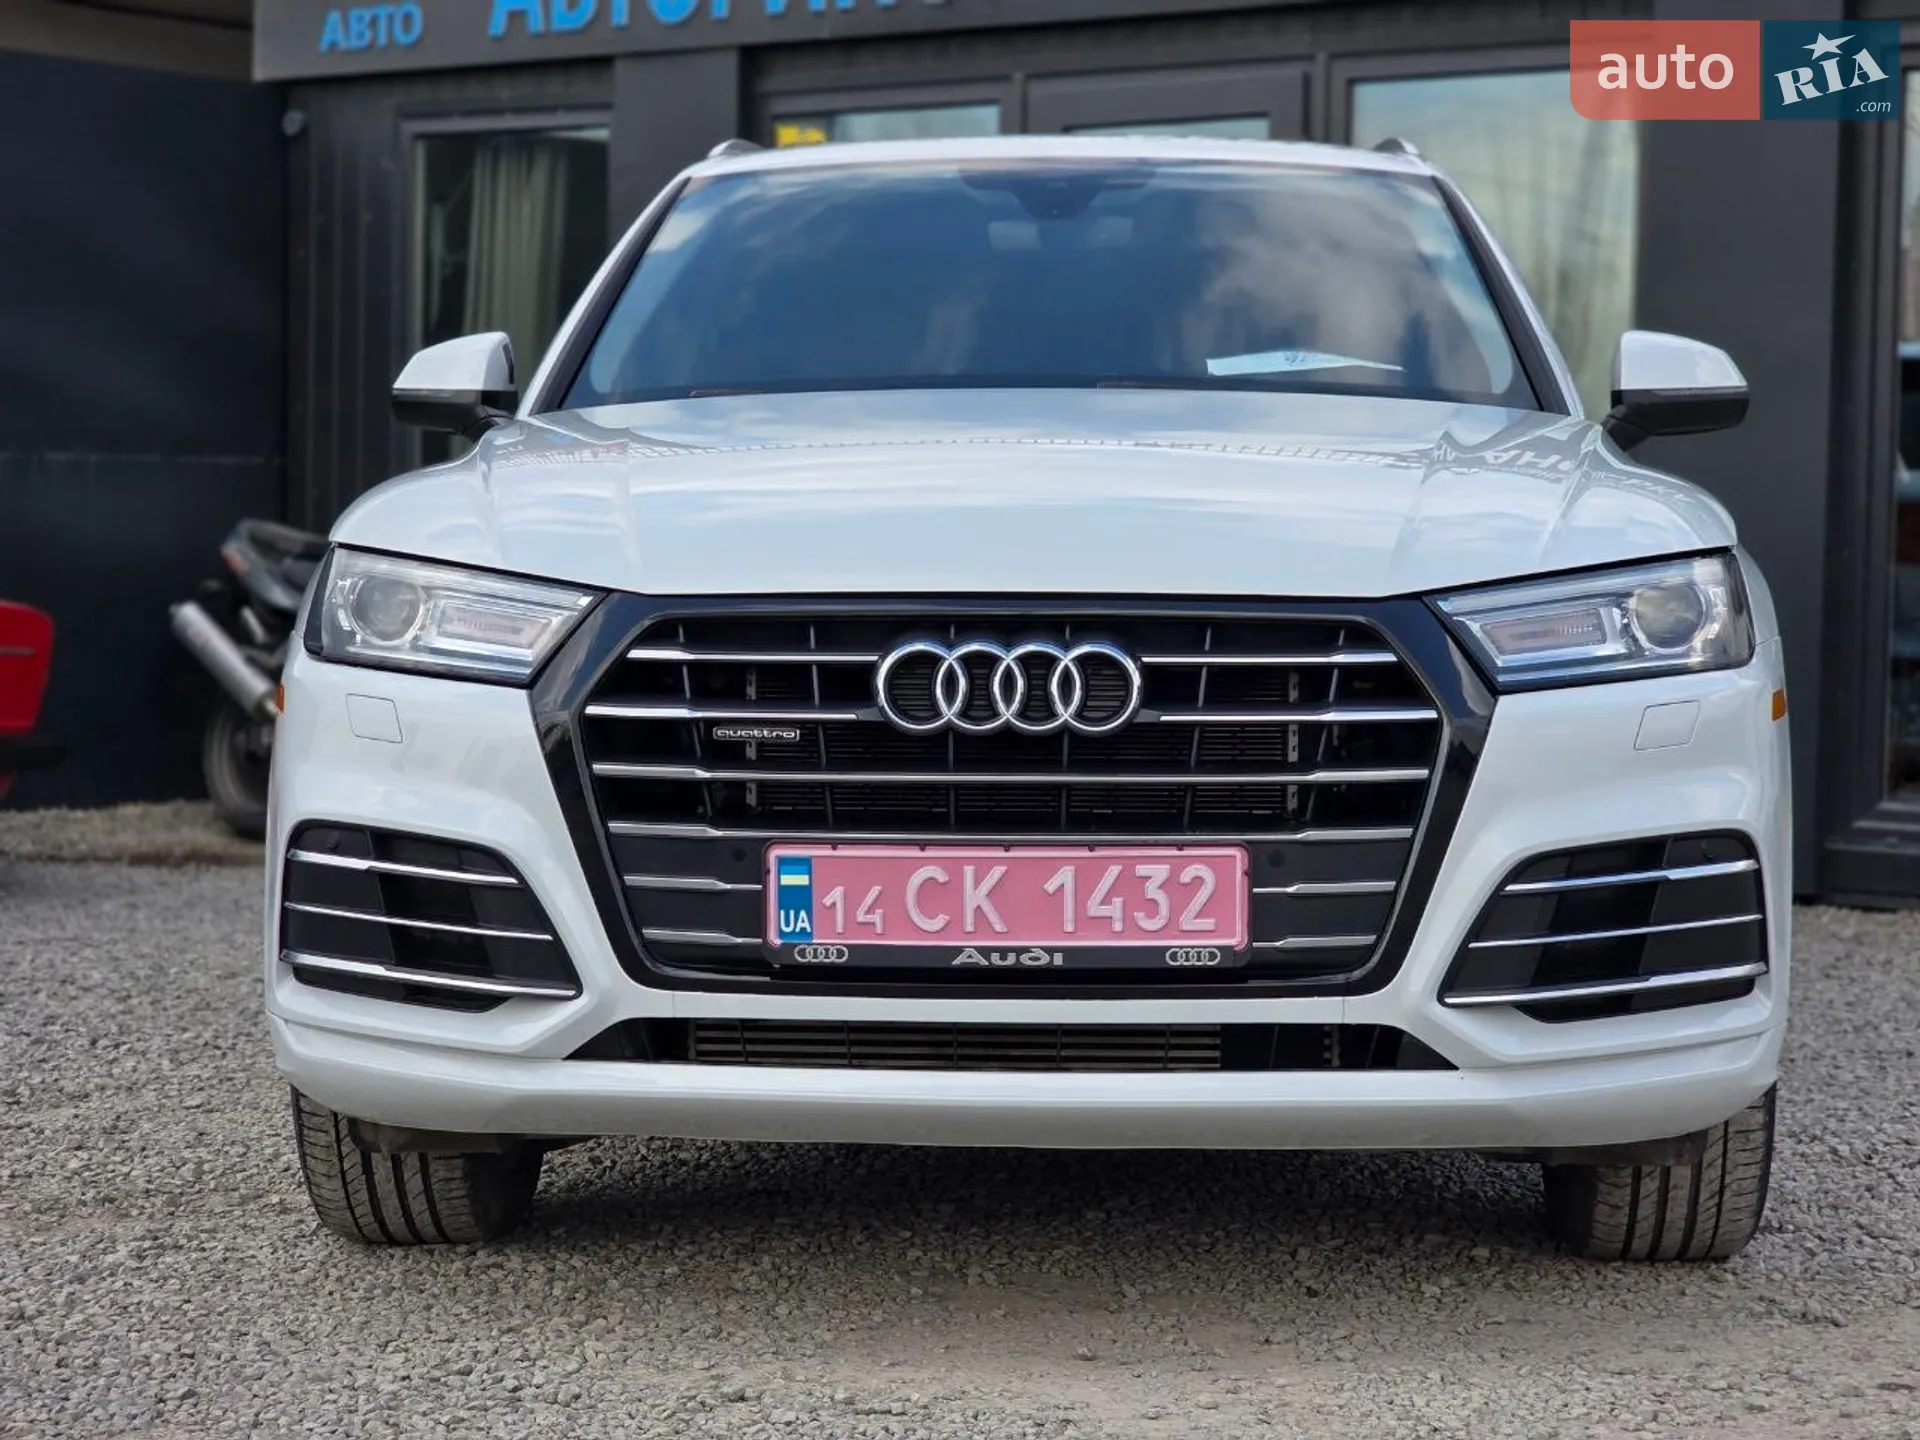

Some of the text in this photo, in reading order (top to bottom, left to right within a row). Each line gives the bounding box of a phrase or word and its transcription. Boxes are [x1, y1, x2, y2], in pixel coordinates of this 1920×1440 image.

[318, 3, 424, 53] АВТО
[716, 729, 796, 739] quattro
[822, 864, 1217, 934] 14 CK 1432
[780, 909, 811, 933] UA
[951, 948, 1063, 966] Audi
